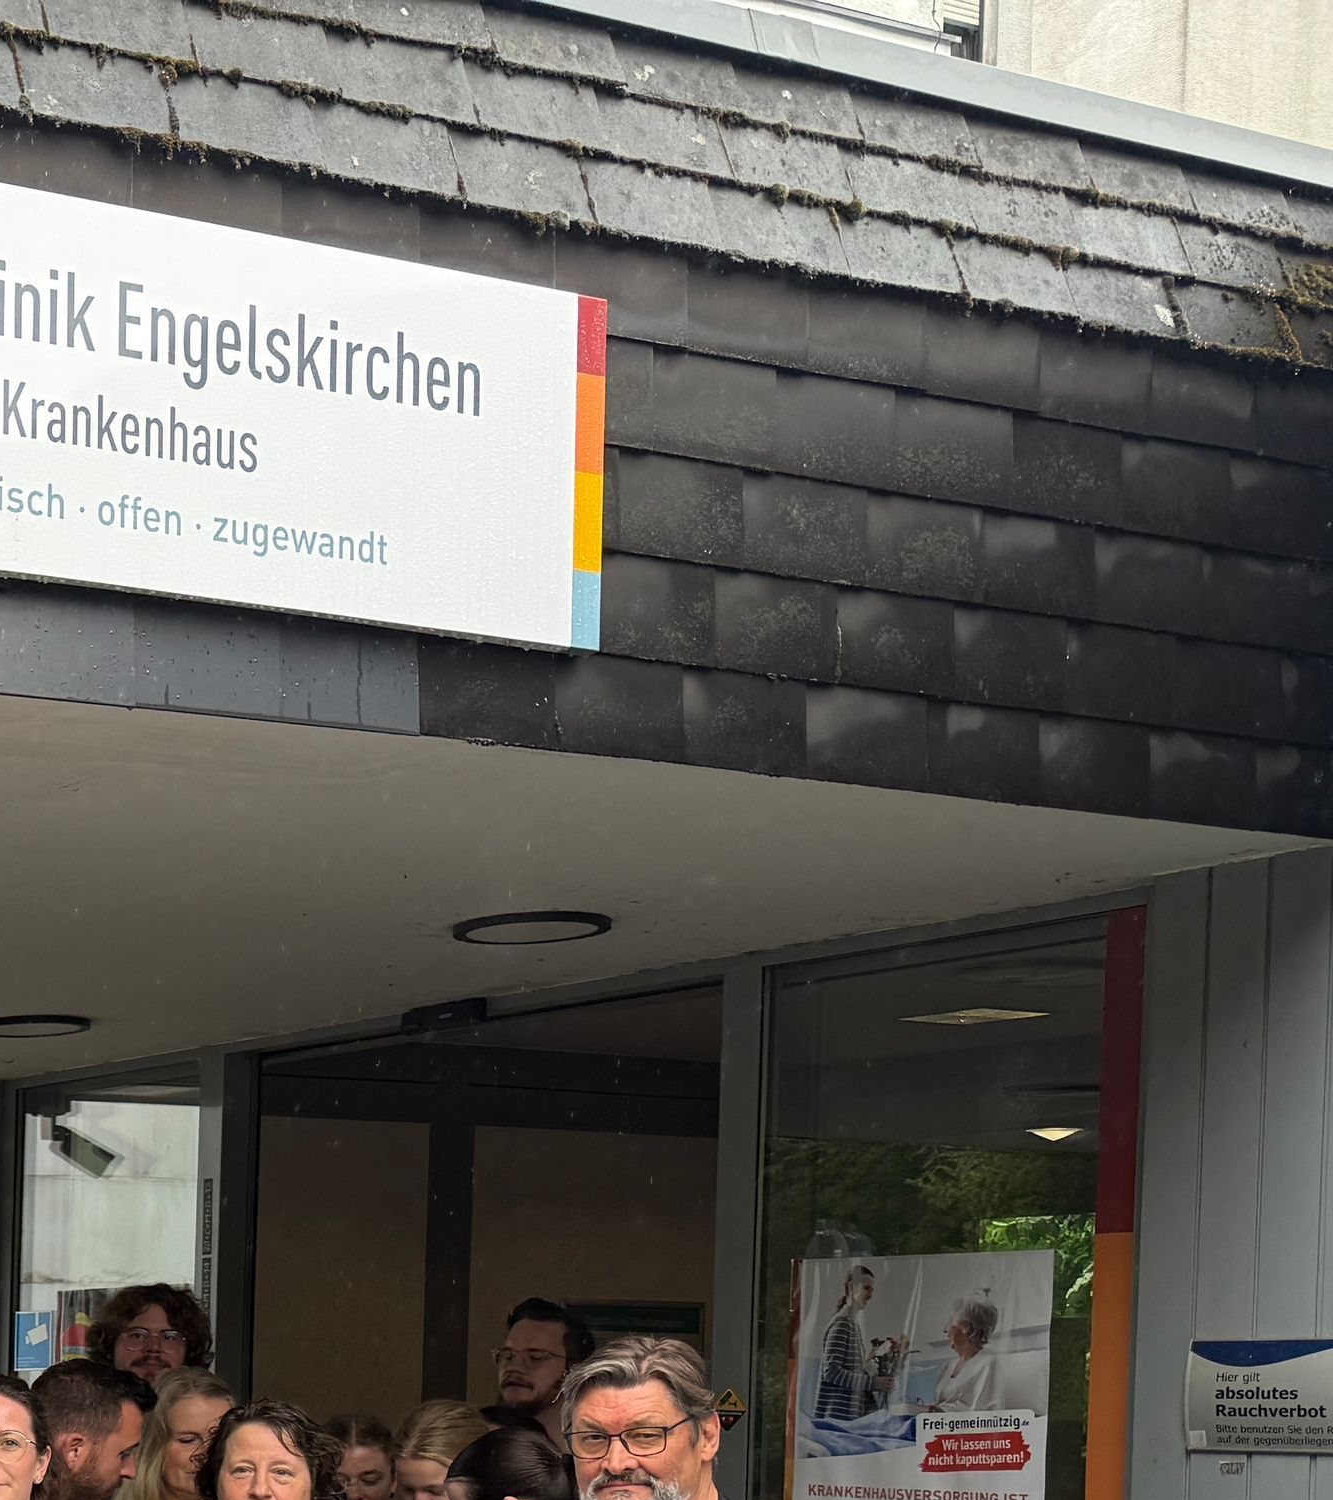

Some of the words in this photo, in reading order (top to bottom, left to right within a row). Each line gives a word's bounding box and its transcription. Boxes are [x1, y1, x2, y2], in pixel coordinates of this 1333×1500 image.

[118, 280, 483, 417] Engelskirchen
[1, 378, 260, 474] Krankenhaus
[96, 495, 184, 539] offen
[212, 513, 389, 566] zugewandt
[1215, 1372, 1239, 1382] Hier
[1242, 1372, 1261, 1385] gilt
[1215, 1386, 1299, 1400] absolutes
[1215, 1404, 1327, 1418] Rauchverbot
[1240, 1425, 1285, 1434] benutzen
[941, 1438, 959, 1450] Wir
[960, 1438, 992, 1450] lassen
[993, 1439, 1011, 1450] uns
[1234, 1435, 1250, 1444] der
[928, 1454, 954, 1466] nicht
[955, 1451, 1025, 1468] kaputtsparen!
